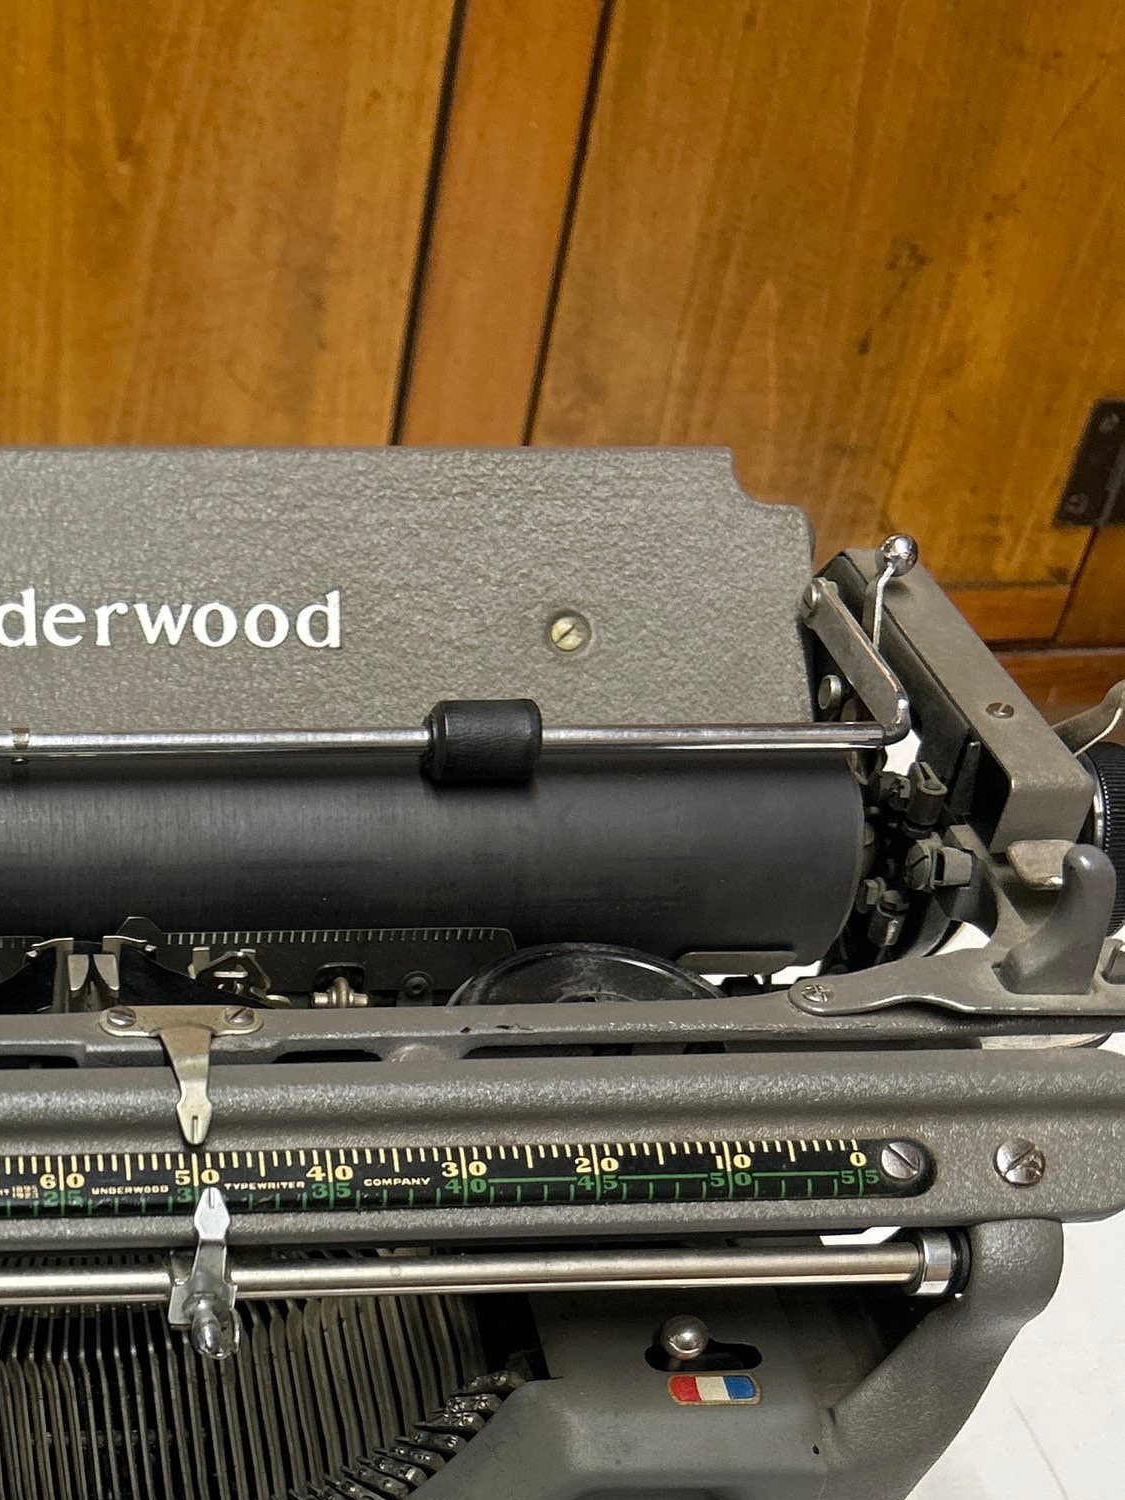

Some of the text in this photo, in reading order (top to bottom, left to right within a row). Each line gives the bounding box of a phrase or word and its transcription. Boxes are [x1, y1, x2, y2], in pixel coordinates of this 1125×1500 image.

[39, 1173, 85, 1191] 60
[174, 1169, 220, 1186] 50
[306, 1165, 354, 1182] 40
[441, 1160, 487, 1178] 30
[574, 1157, 619, 1173] 20
[715, 1154, 751, 1170] 10
[849, 1151, 867, 1167] 0
[44, 1190, 83, 1207] 25
[312, 1182, 351, 1198] 35
[445, 1178, 487, 1194] 40
[577, 1174, 618, 1190] 45
[709, 1172, 752, 1188] 50
[840, 1170, 880, 1185] 55
[91, 1184, 169, 1195] UNDERWOOD
[224, 1181, 305, 1191] TYPEWRITER
[363, 1177, 431, 1187] COMPANY
